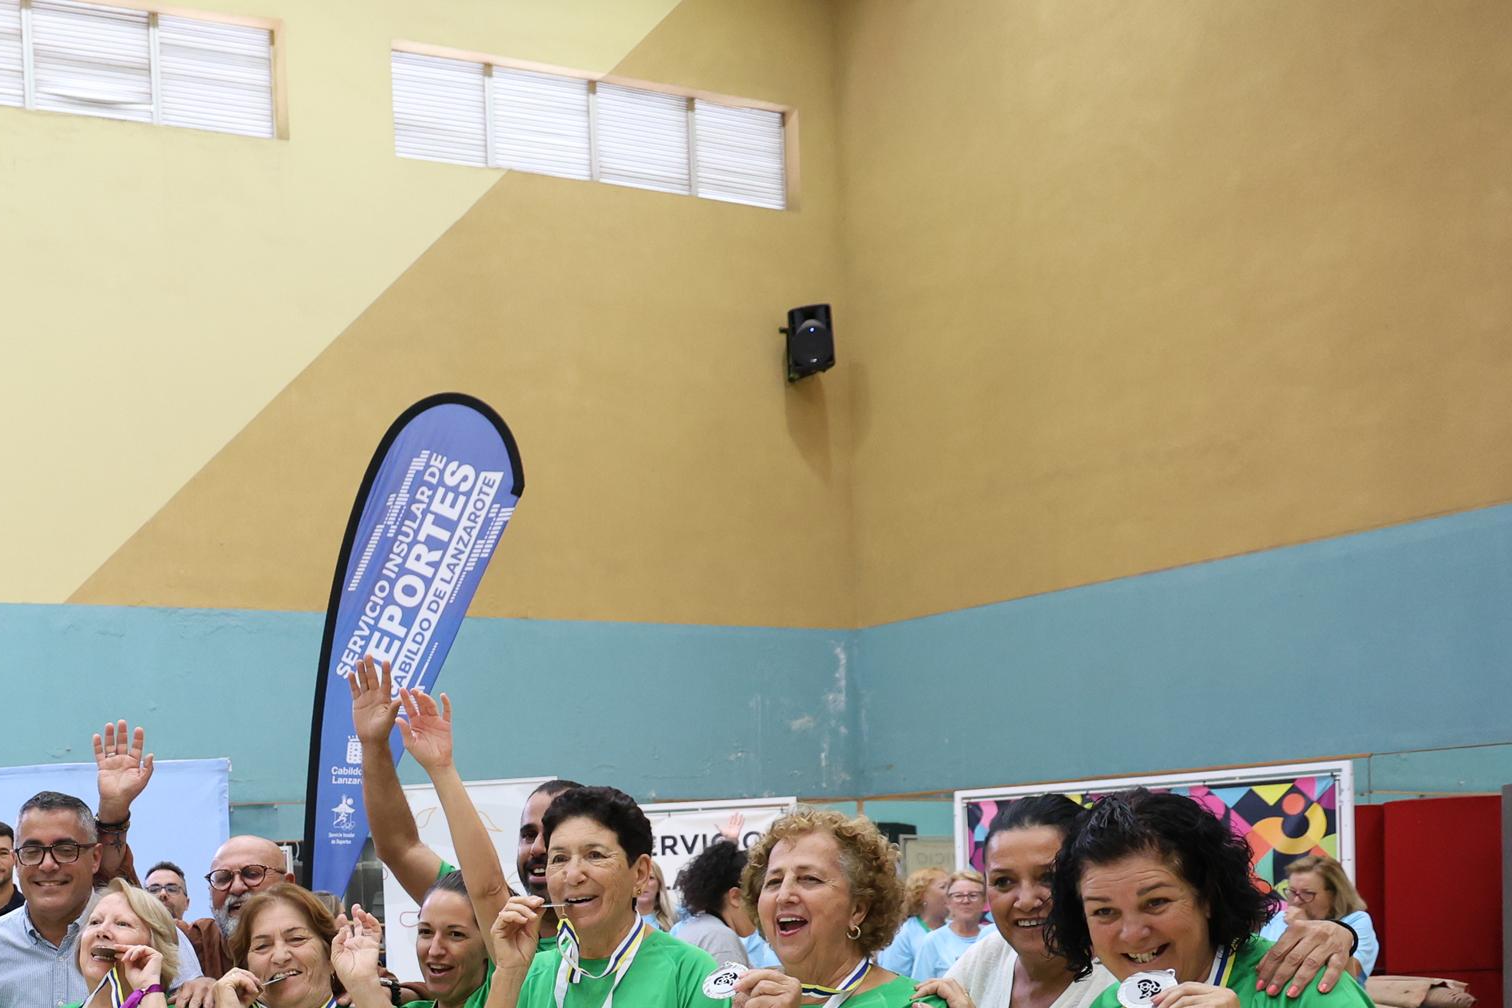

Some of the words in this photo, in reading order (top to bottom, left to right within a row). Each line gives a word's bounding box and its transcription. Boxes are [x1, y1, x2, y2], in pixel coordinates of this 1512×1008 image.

[336, 580, 390, 680] SERVICIO
[382, 486, 433, 579] INSULAR
[423, 453, 447, 485] DE
[427, 587, 447, 615] DE
[440, 474, 497, 585] LANZAROTE
[332, 776, 363, 785] Lanzar
